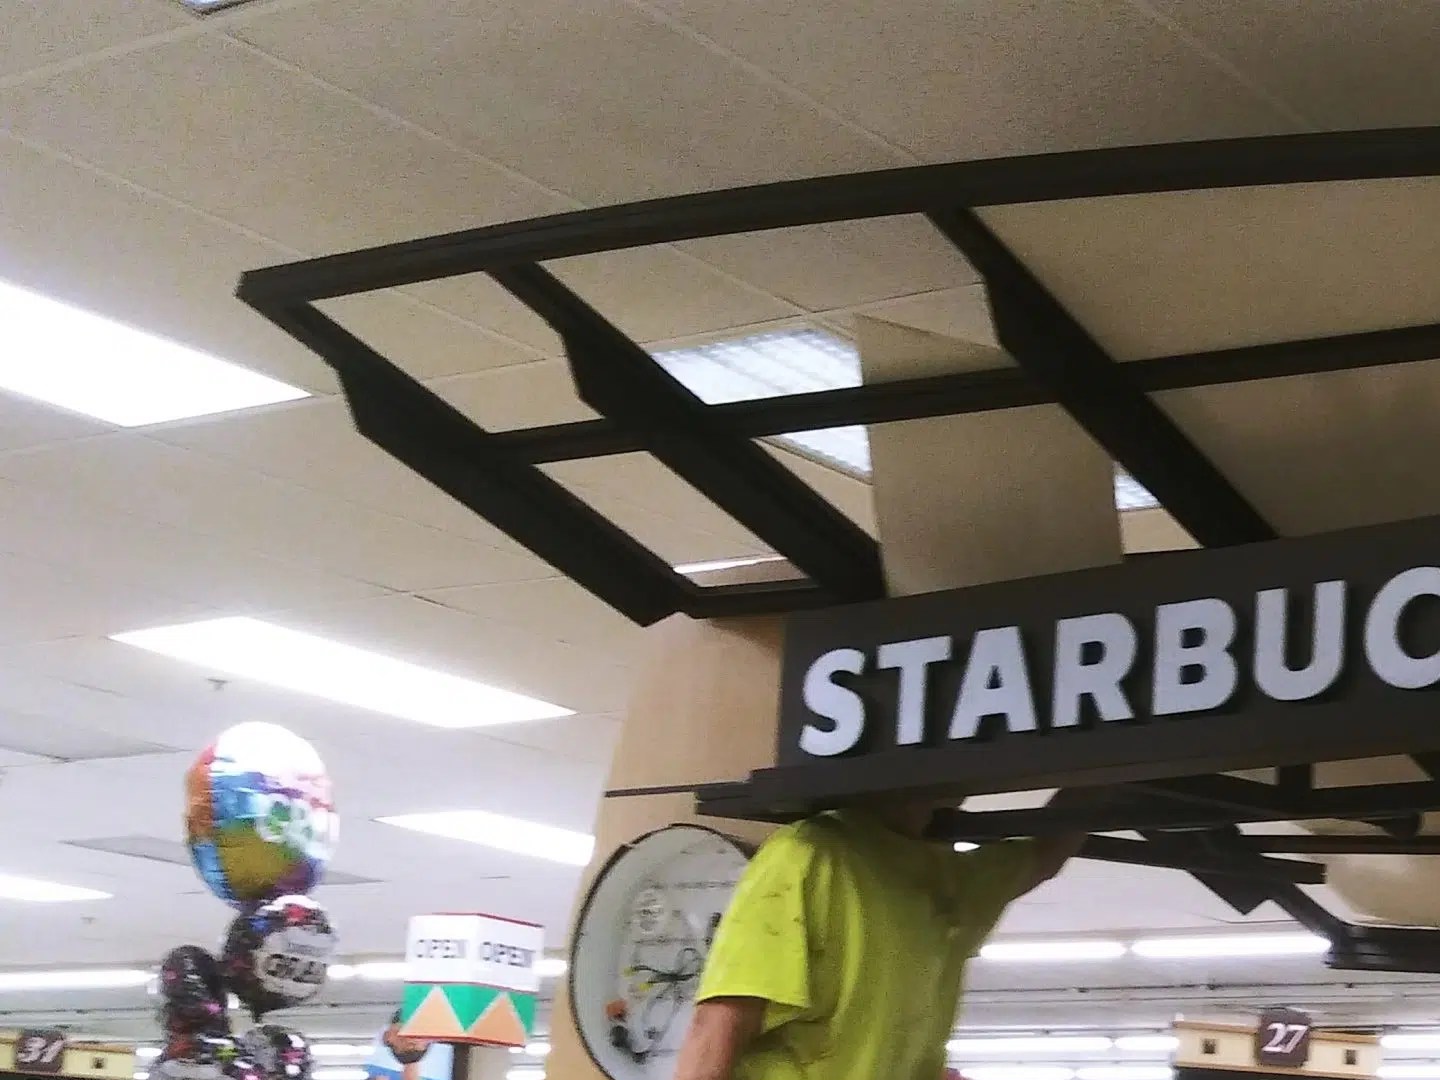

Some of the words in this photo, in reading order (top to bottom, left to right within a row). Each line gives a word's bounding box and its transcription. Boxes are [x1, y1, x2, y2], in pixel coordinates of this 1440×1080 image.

[416, 939, 467, 958] OPEN
[482, 941, 534, 968] OPEN
[17, 1036, 65, 1063] 31
[1262, 1022, 1308, 1054] 27
